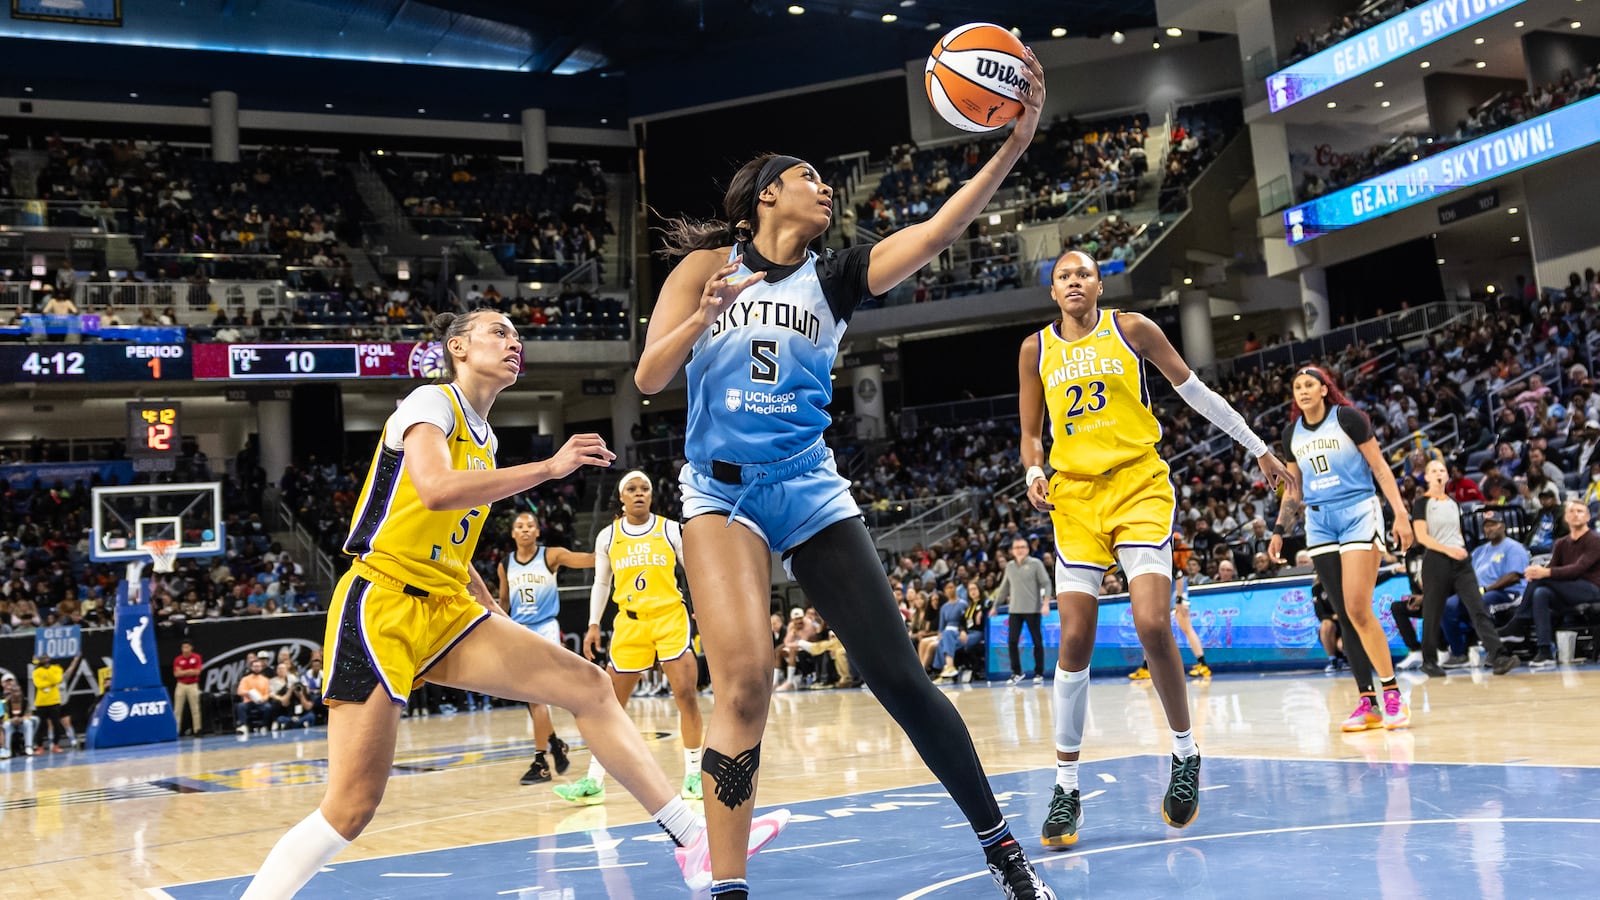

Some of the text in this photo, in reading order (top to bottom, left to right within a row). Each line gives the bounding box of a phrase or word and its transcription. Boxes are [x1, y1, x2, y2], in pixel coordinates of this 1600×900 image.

[1333, 37, 1380, 75] GEAR
[1385, 20, 1415, 52] UP,
[977, 56, 1033, 97] Wilson
[1351, 121, 1555, 217] GEAR UP, SKYTOWN!
[126, 346, 183, 359] PERIOD
[232, 348, 261, 361] TOL
[360, 344, 395, 357] FOUL
[750, 338, 779, 385] 5
[1061, 346, 1097, 366] LOS
[22, 352, 85, 375] 4:12
[147, 357, 161, 379] 1
[285, 351, 315, 373] 10
[365, 356, 381, 368] 01
[1047, 357, 1124, 391] ANGELES
[745, 390, 795, 404] UChicago
[1065, 381, 1107, 418] 23
[744, 403, 798, 415] Medicine
[147, 424, 173, 450] 12
[1309, 454, 1331, 476] 10
[451, 508, 480, 545] 5
[627, 543, 651, 556] LOS
[615, 553, 667, 571] ANGELES
[635, 569, 647, 592] 6
[518, 588, 535, 604] 15
[44, 627, 72, 639] GET
[130, 700, 167, 718] AT&T
